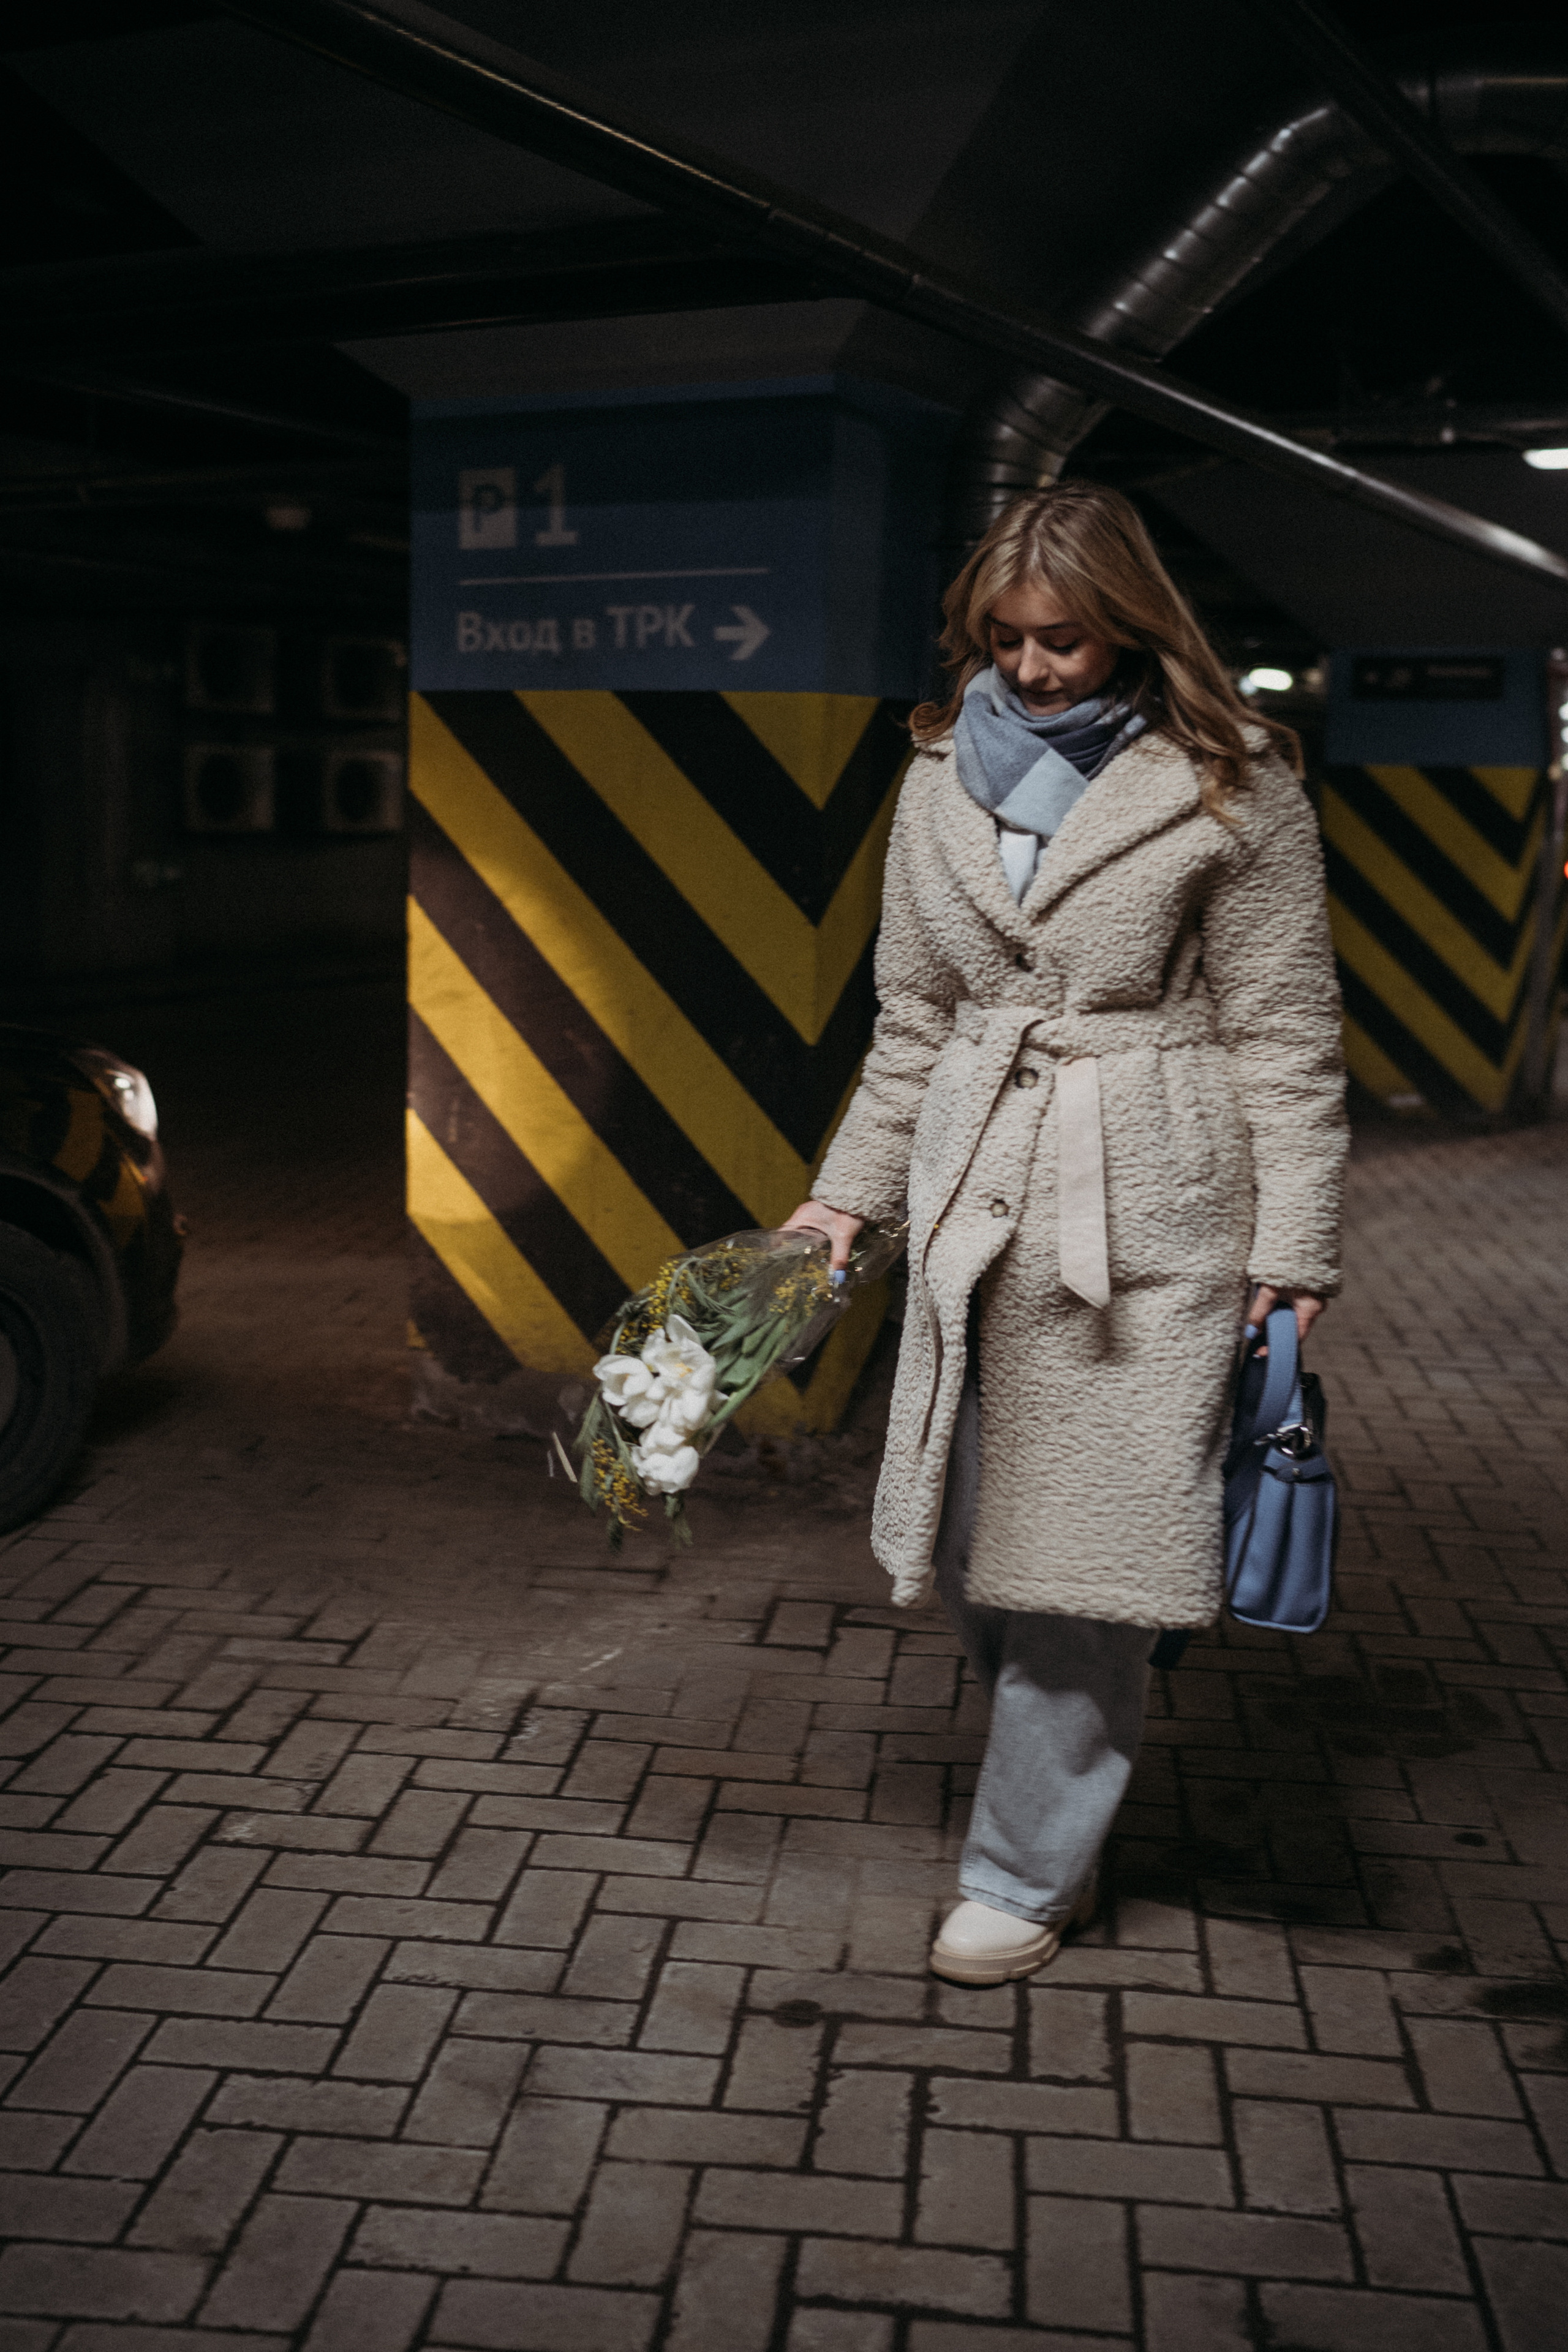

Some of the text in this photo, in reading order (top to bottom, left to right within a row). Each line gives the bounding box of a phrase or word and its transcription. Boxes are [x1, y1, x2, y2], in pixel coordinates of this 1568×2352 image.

[533, 464, 579, 546] 1
[457, 604, 696, 657] Вход в ТРК
